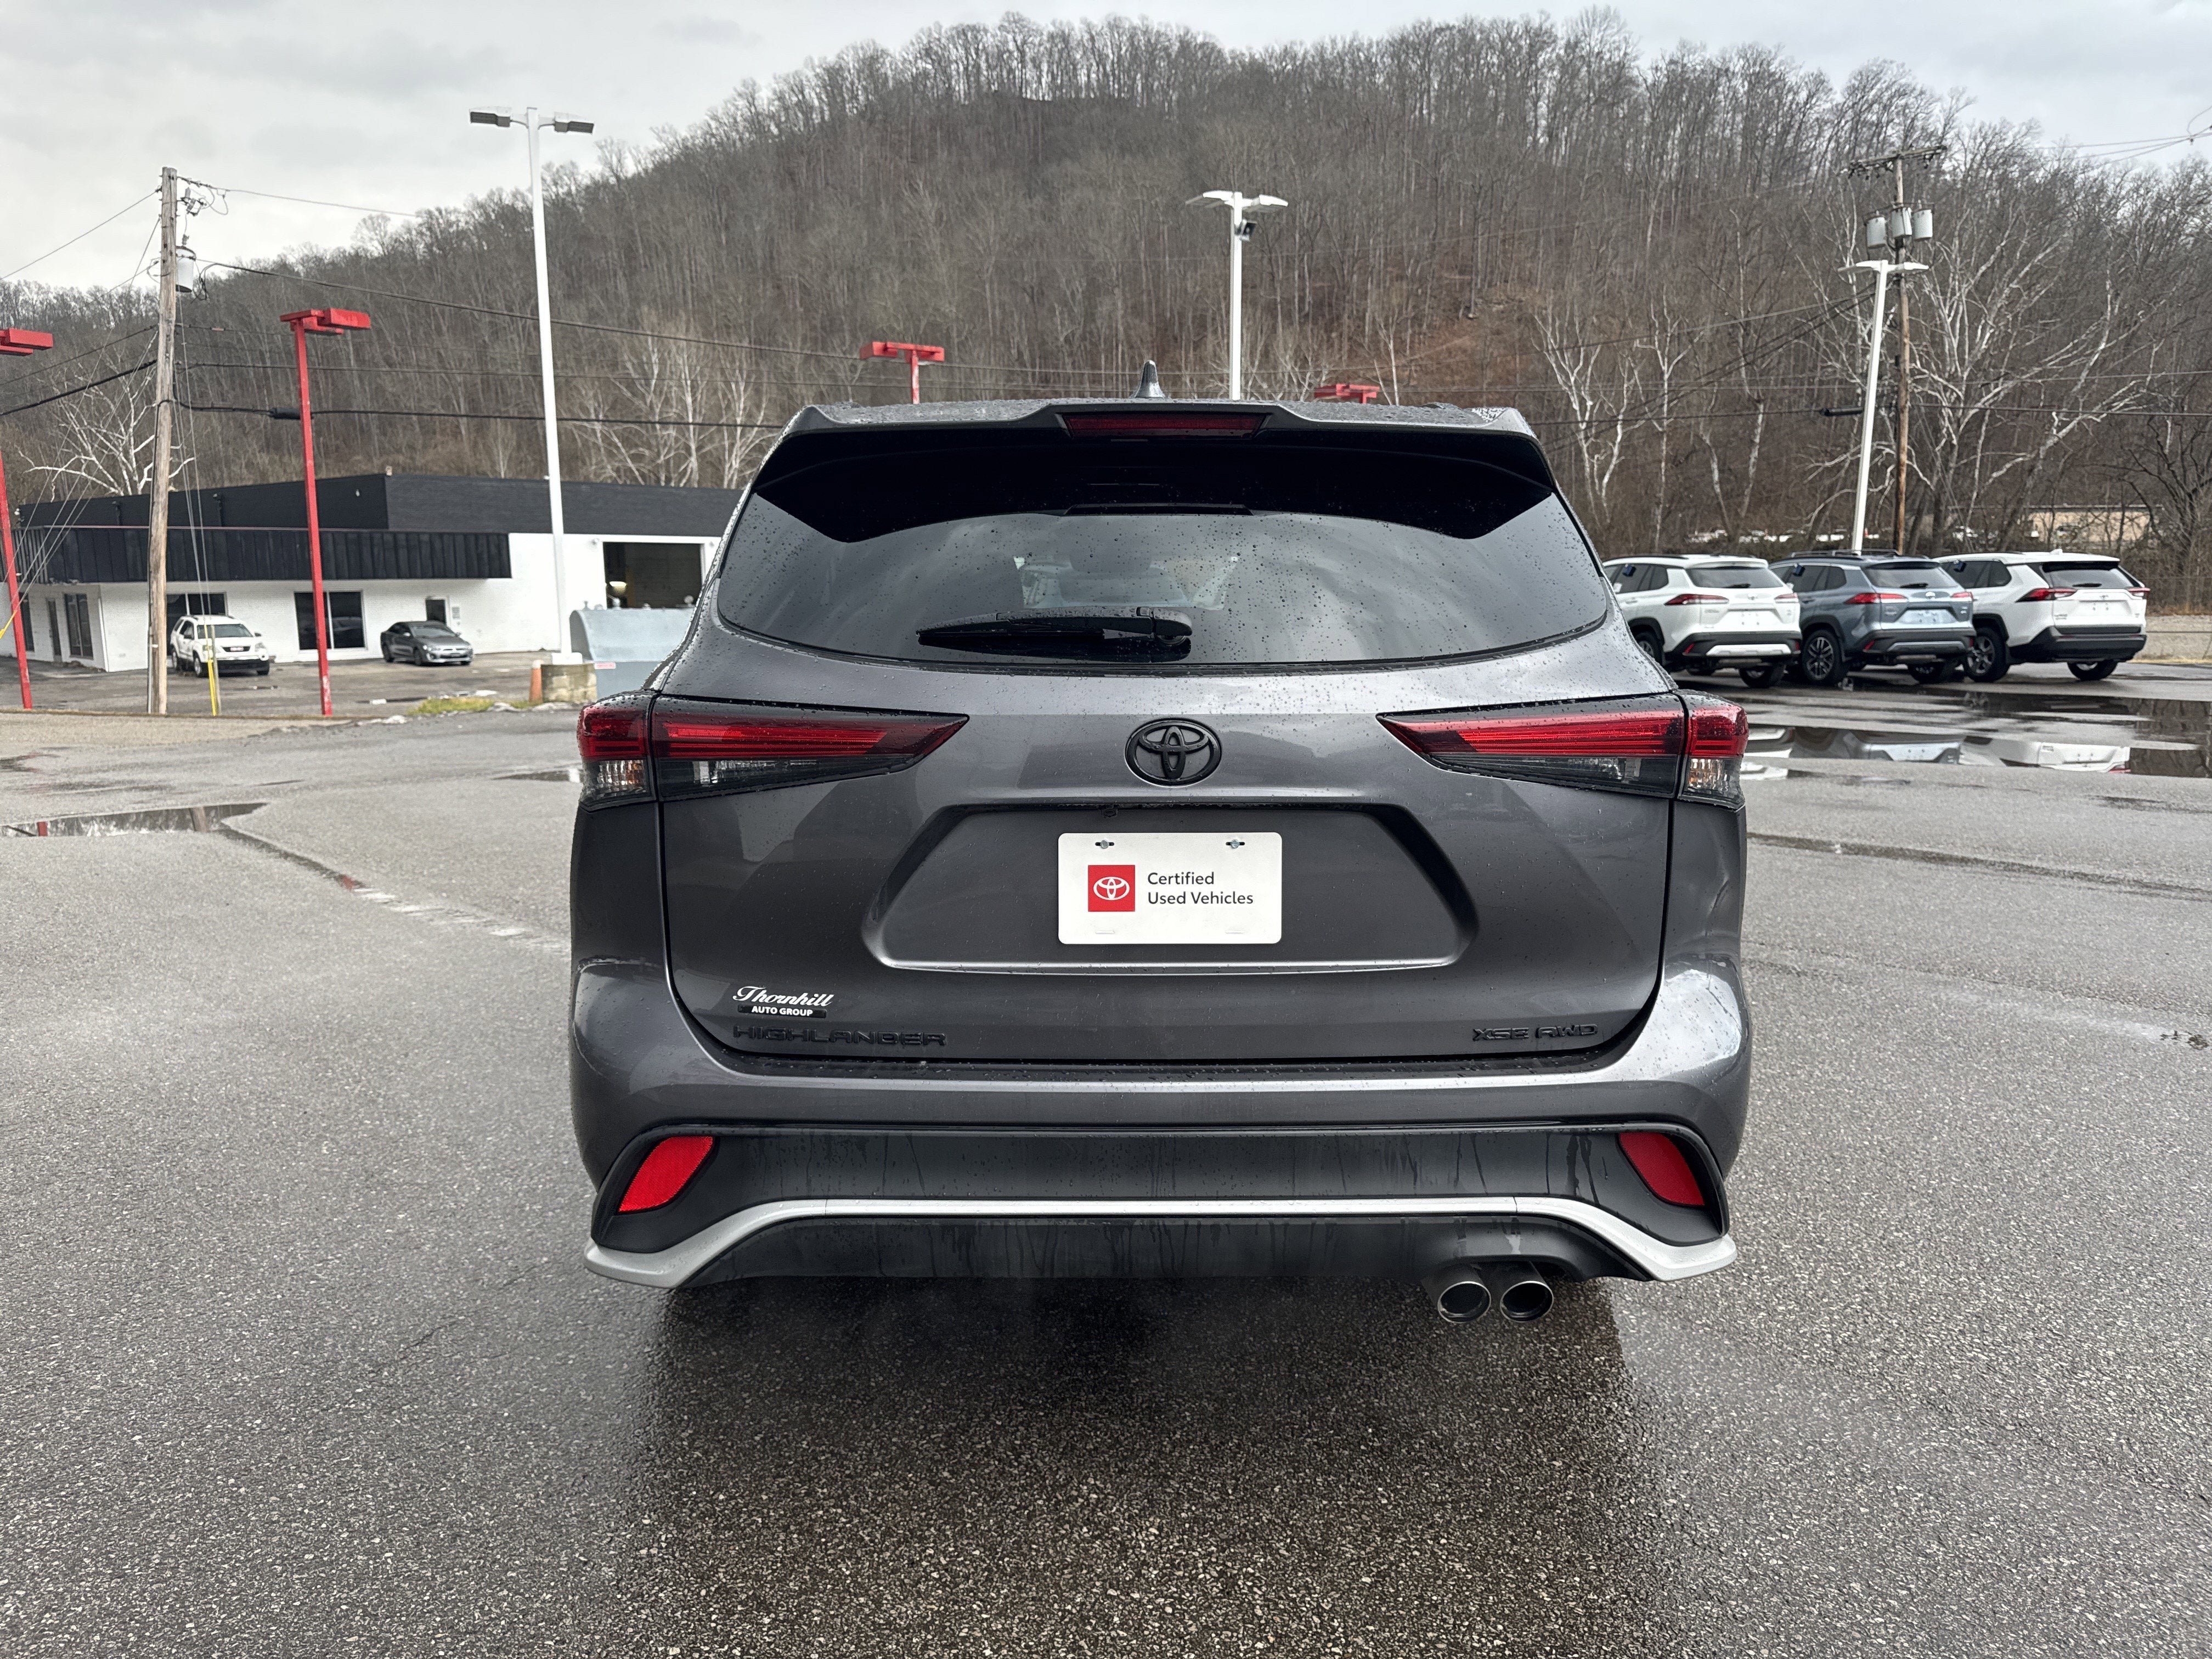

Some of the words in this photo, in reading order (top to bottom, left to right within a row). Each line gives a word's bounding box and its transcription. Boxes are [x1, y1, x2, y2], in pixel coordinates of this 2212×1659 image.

[1148, 872, 1214, 884] Certified
[1148, 891, 1186, 904] Used
[1190, 891, 1254, 904] Vehicles
[732, 986, 834, 1007] Thornhill
[752, 1006, 777, 1014] AUTO
[779, 1008, 813, 1017] GROUP
[733, 1025, 946, 1046] HIGHLANDER
[1472, 1027, 1530, 1041] XSE
[1535, 1024, 1598, 1039] AWD
